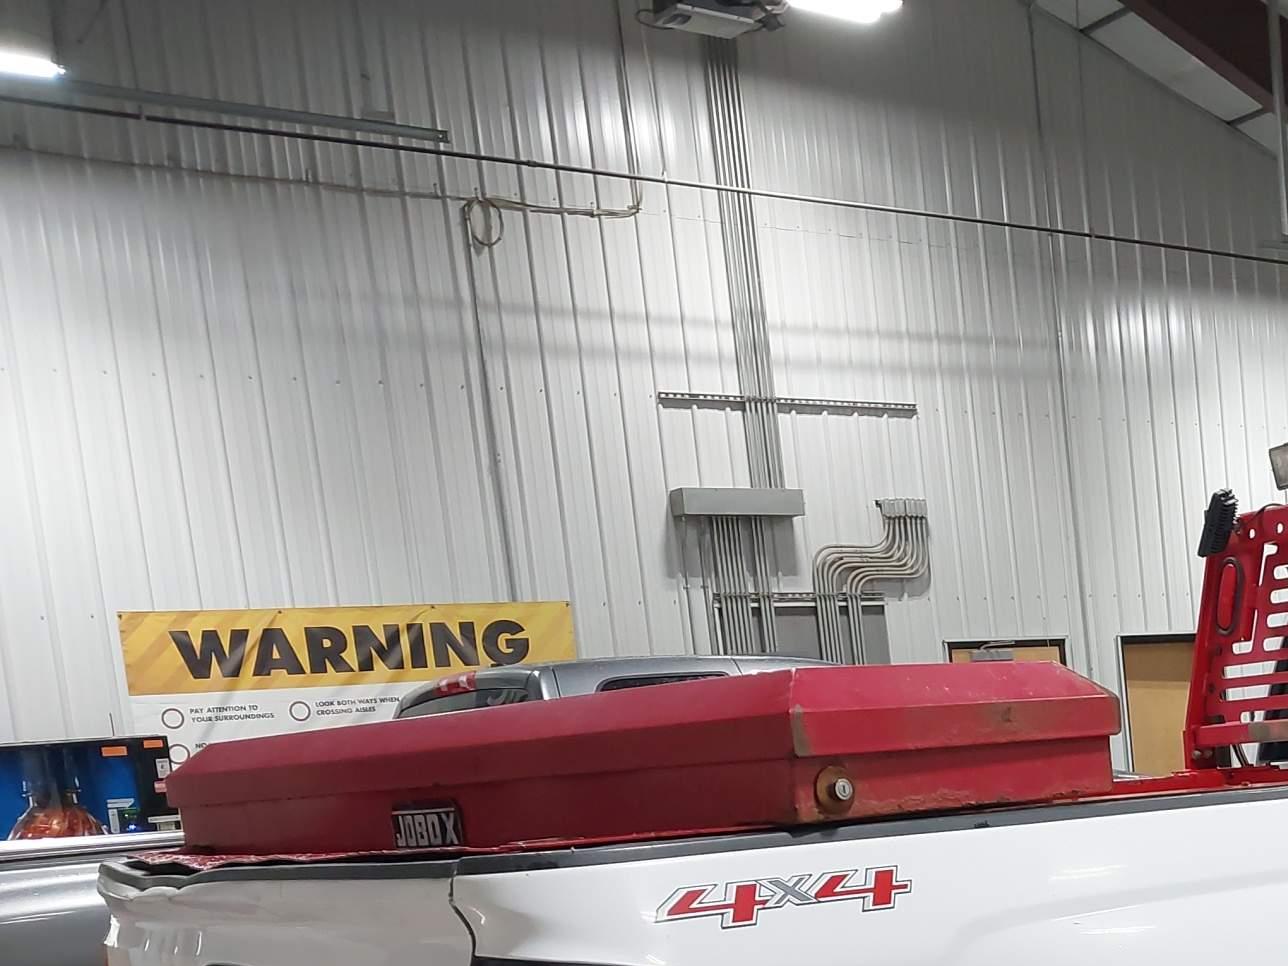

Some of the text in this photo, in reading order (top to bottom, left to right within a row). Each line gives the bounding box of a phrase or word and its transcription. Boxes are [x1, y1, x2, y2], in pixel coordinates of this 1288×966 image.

[169, 619, 530, 679] WARNING
[357, 697, 378, 705] WAYS
[206, 705, 247, 713] ATTENTION
[316, 707, 353, 716] CROSSING
[214, 712, 275, 722] SURROUNDINGS
